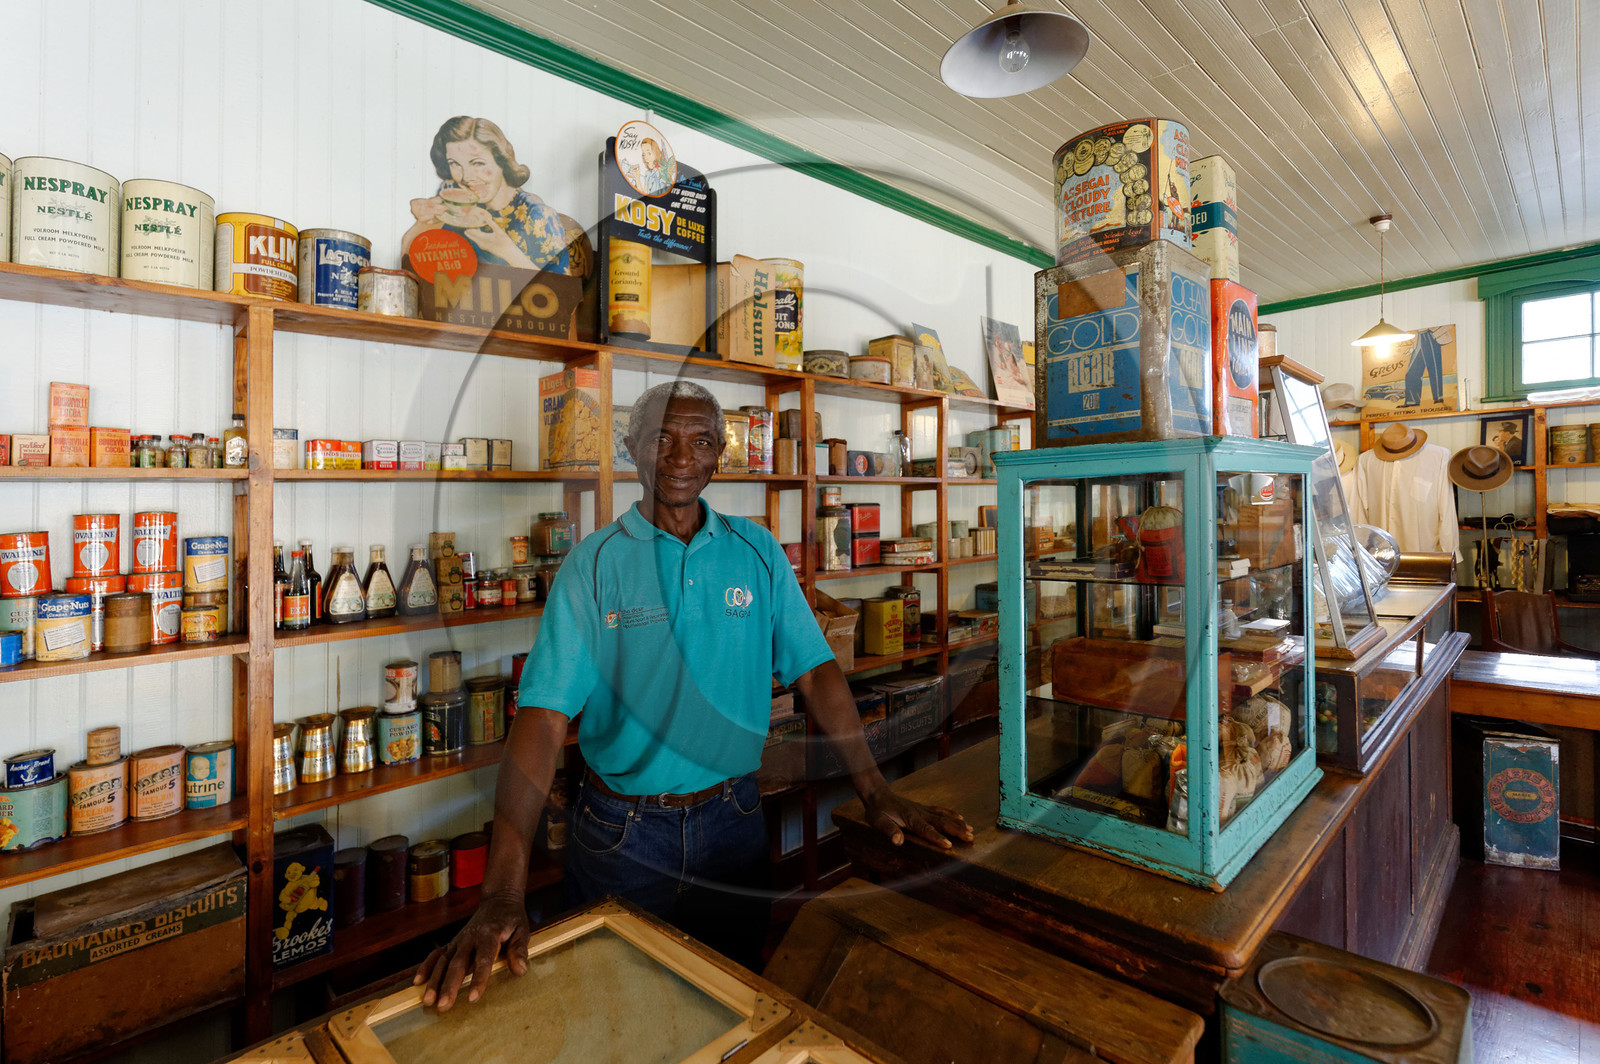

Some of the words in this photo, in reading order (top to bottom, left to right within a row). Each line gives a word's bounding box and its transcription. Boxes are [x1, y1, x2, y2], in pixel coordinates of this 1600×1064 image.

[623, 127, 638, 141] Say
[24, 176, 108, 204] NESPRAY
[1064, 174, 1110, 203] ASSEGAI
[126, 196, 198, 218] NESPRAY
[1066, 188, 1110, 214] CLOUDY
[37, 205, 93, 222] NESTLÉ
[615, 193, 676, 236] KOSY
[1064, 202, 1111, 228] MIXTURE
[134, 224, 182, 236] NESTLÉ
[676, 216, 686, 227] DE
[688, 219, 705, 234] LUXE
[59, 238, 92, 248] POWDERED
[638, 228, 652, 240] Taste
[653, 232, 662, 244] the
[676, 227, 705, 244] COFFEE
[151, 253, 180, 261] POWDERED
[250, 236, 296, 266] KLIM
[414, 248, 468, 262] VITAMINS
[262, 258, 276, 266] FULL
[614, 269, 640, 277] Ground
[611, 278, 642, 287] Coriander
[434, 272, 559, 318] MILO
[436, 312, 496, 326] NESTLÉ
[753, 268, 769, 357] Holsum
[1048, 312, 1140, 354] GOLD
[1171, 310, 1208, 349] GOLD
[1230, 312, 1252, 339] MAIN
[1232, 334, 1255, 358] LINE
[542, 378, 564, 392] Tiger
[60, 408, 82, 418] COCOA
[10, 610, 36, 618] CUST
[41, 600, 89, 612] Grape-Nuts
[142, 784, 168, 796] FAMOUS
[168, 778, 176, 790] 5
[80, 798, 105, 810] FAMOUS
[107, 792, 116, 804] 5
[154, 886, 238, 927] BISCUITS
[91, 936, 141, 960] ASSORTED
[145, 924, 182, 942] CREAMS
[273, 937, 328, 963] LEMOS
